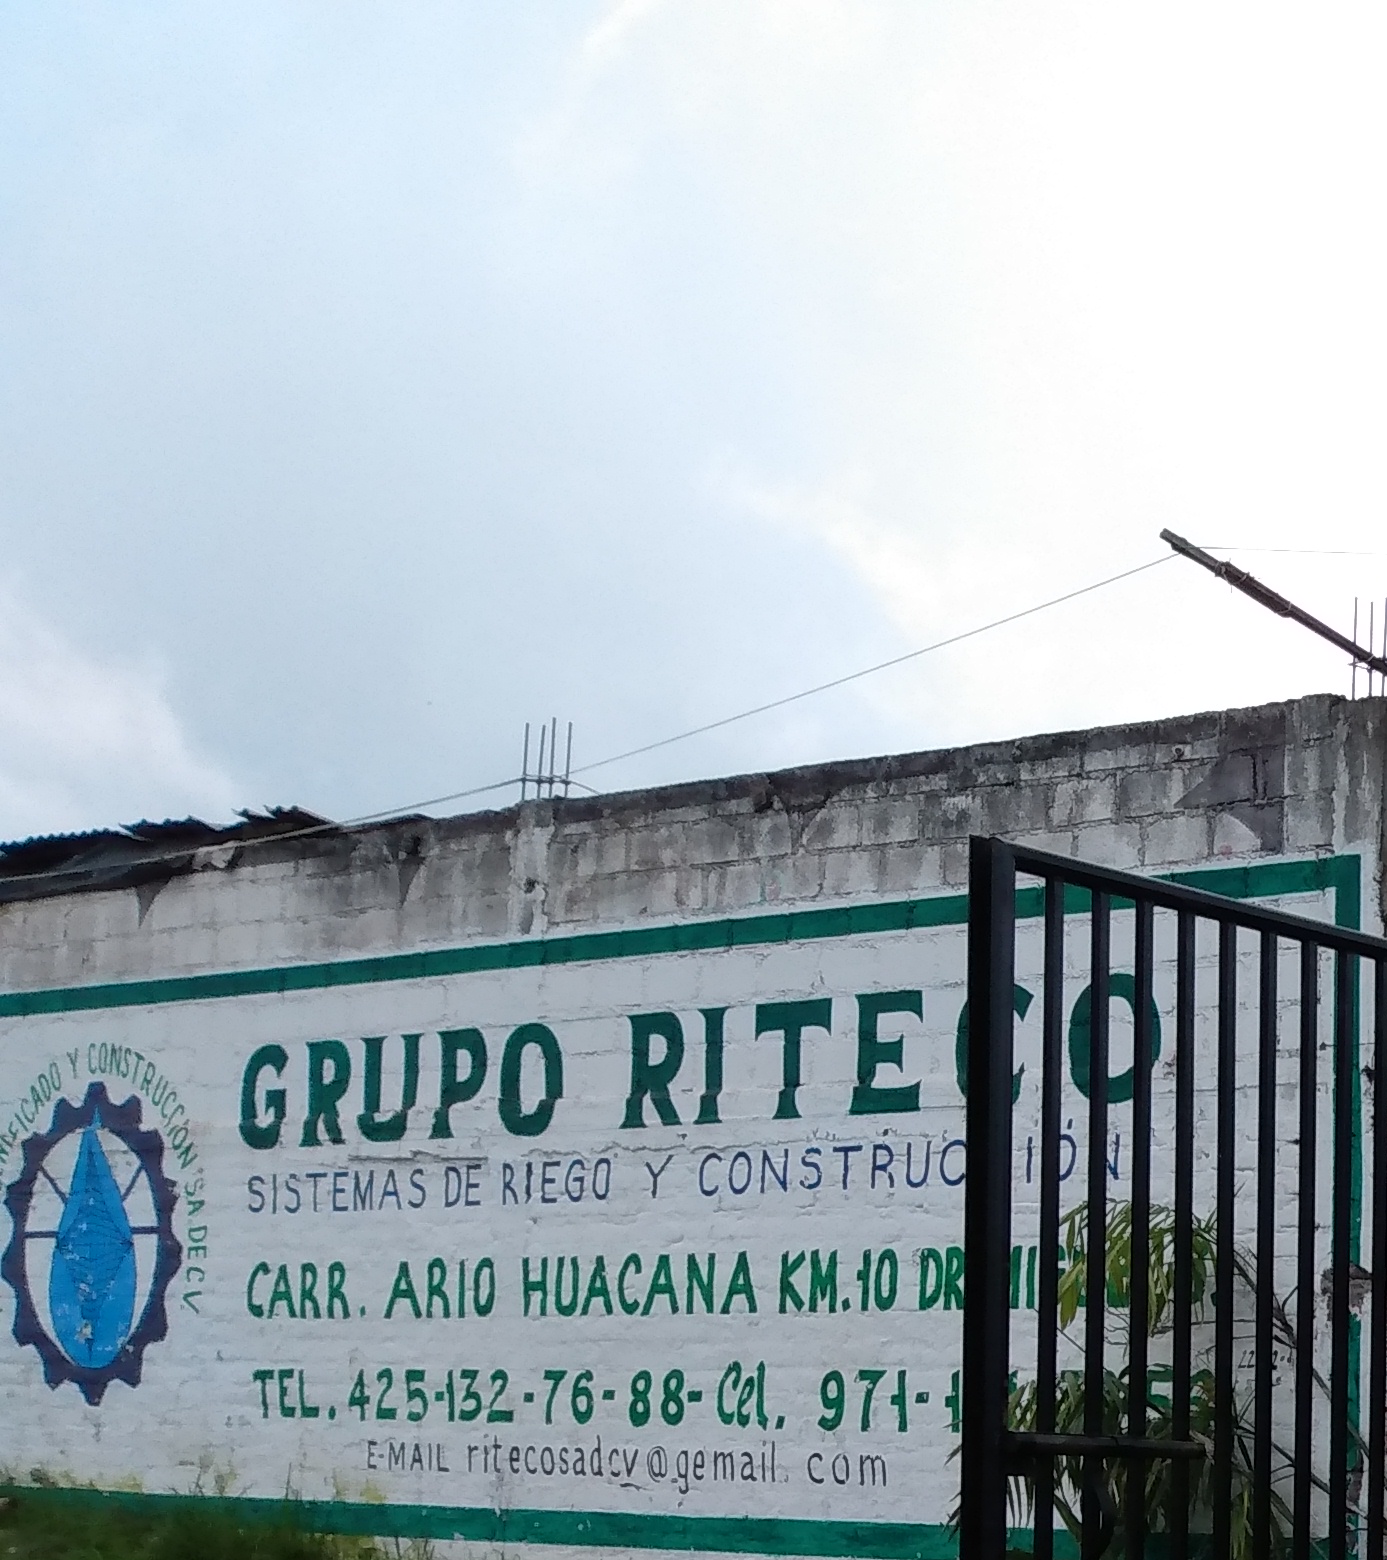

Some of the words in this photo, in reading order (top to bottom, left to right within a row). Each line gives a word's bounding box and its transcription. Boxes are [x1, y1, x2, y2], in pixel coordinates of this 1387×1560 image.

[238, 1022, 564, 1150] GRUPO
[247, 1168, 427, 1215] SISTEMAS
[443, 1163, 482, 1209] DE
[501, 1157, 612, 1206] RIEGO
[645, 1154, 674, 1199] Y
[246, 1259, 367, 1320] CARR.
[383, 1256, 497, 1320] ARIO
[521, 1249, 758, 1318] HUACANA
[366, 1439, 450, 1473] E-MAIL
[806, 1451, 888, 1488] com
